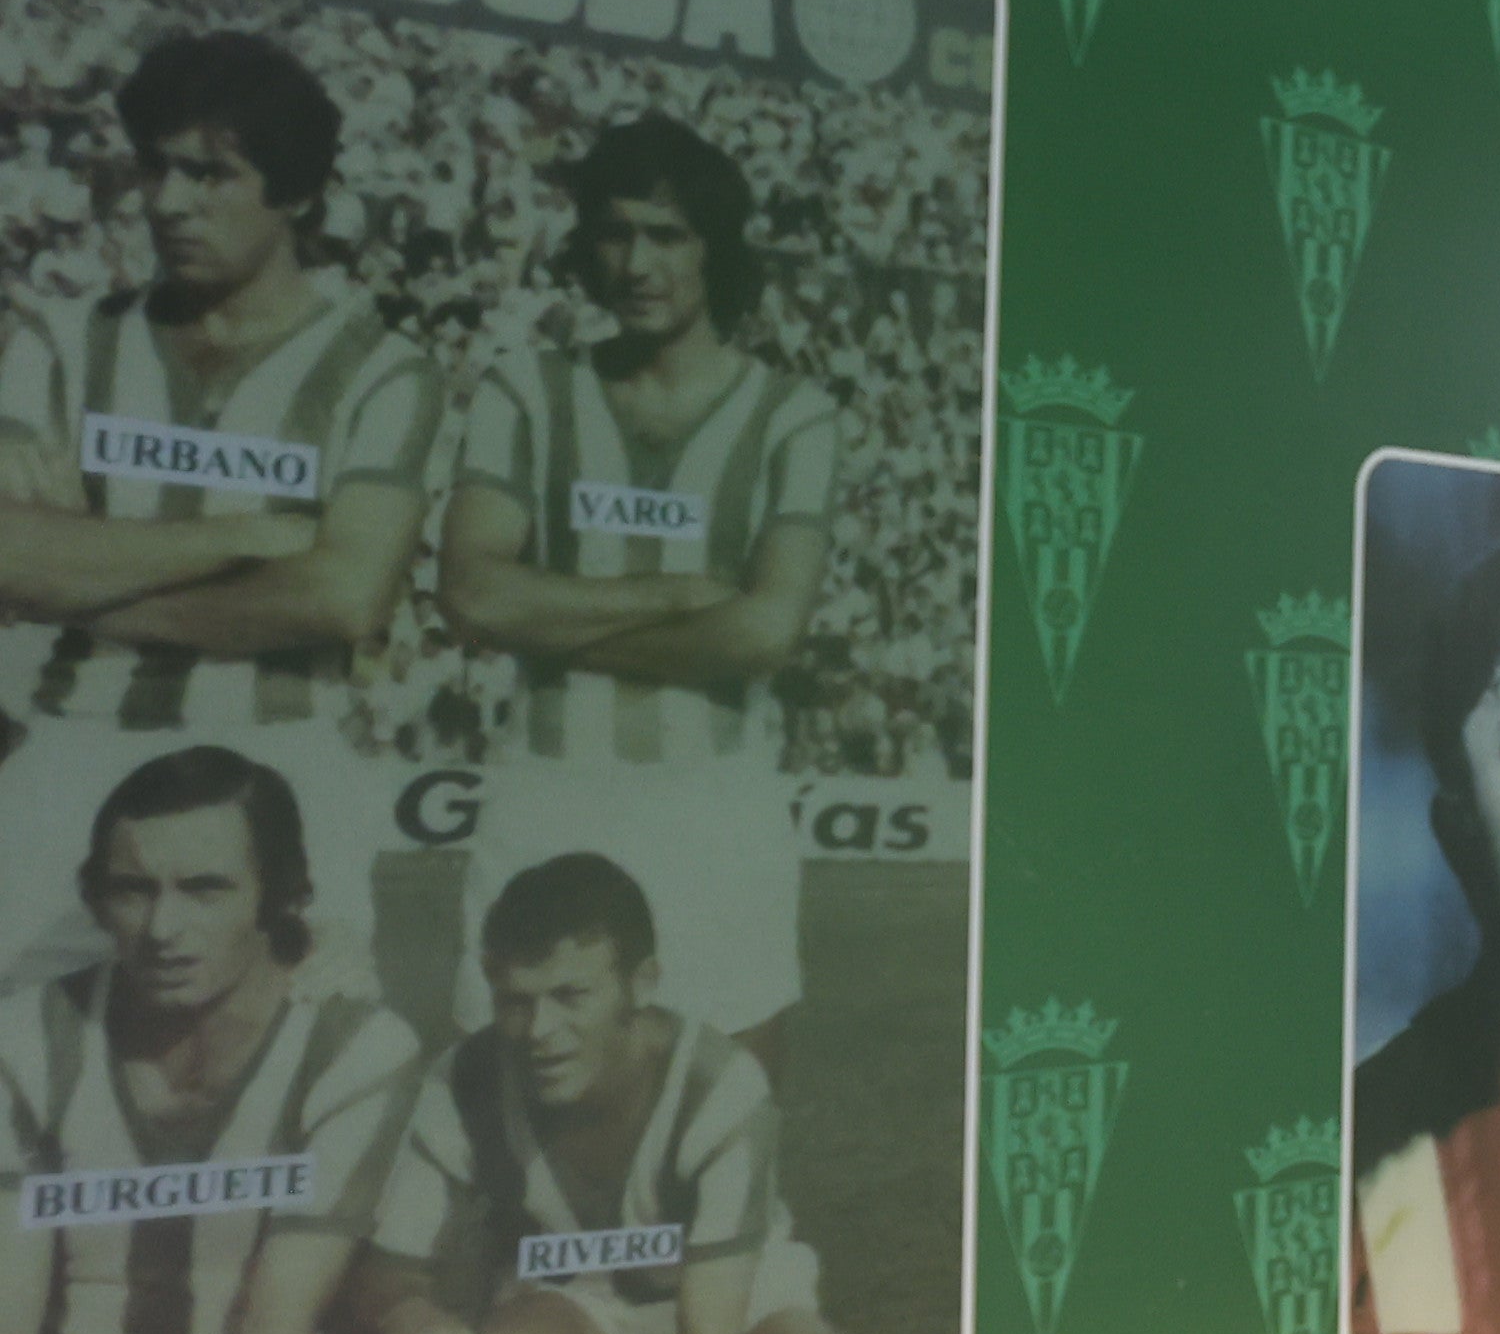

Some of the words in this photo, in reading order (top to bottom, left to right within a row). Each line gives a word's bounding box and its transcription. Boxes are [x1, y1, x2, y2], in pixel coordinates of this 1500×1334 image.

[95, 429, 307, 486] URBANO
[32, 1163, 308, 1218] BURGUETE
[529, 1231, 679, 1272] RIVERO
